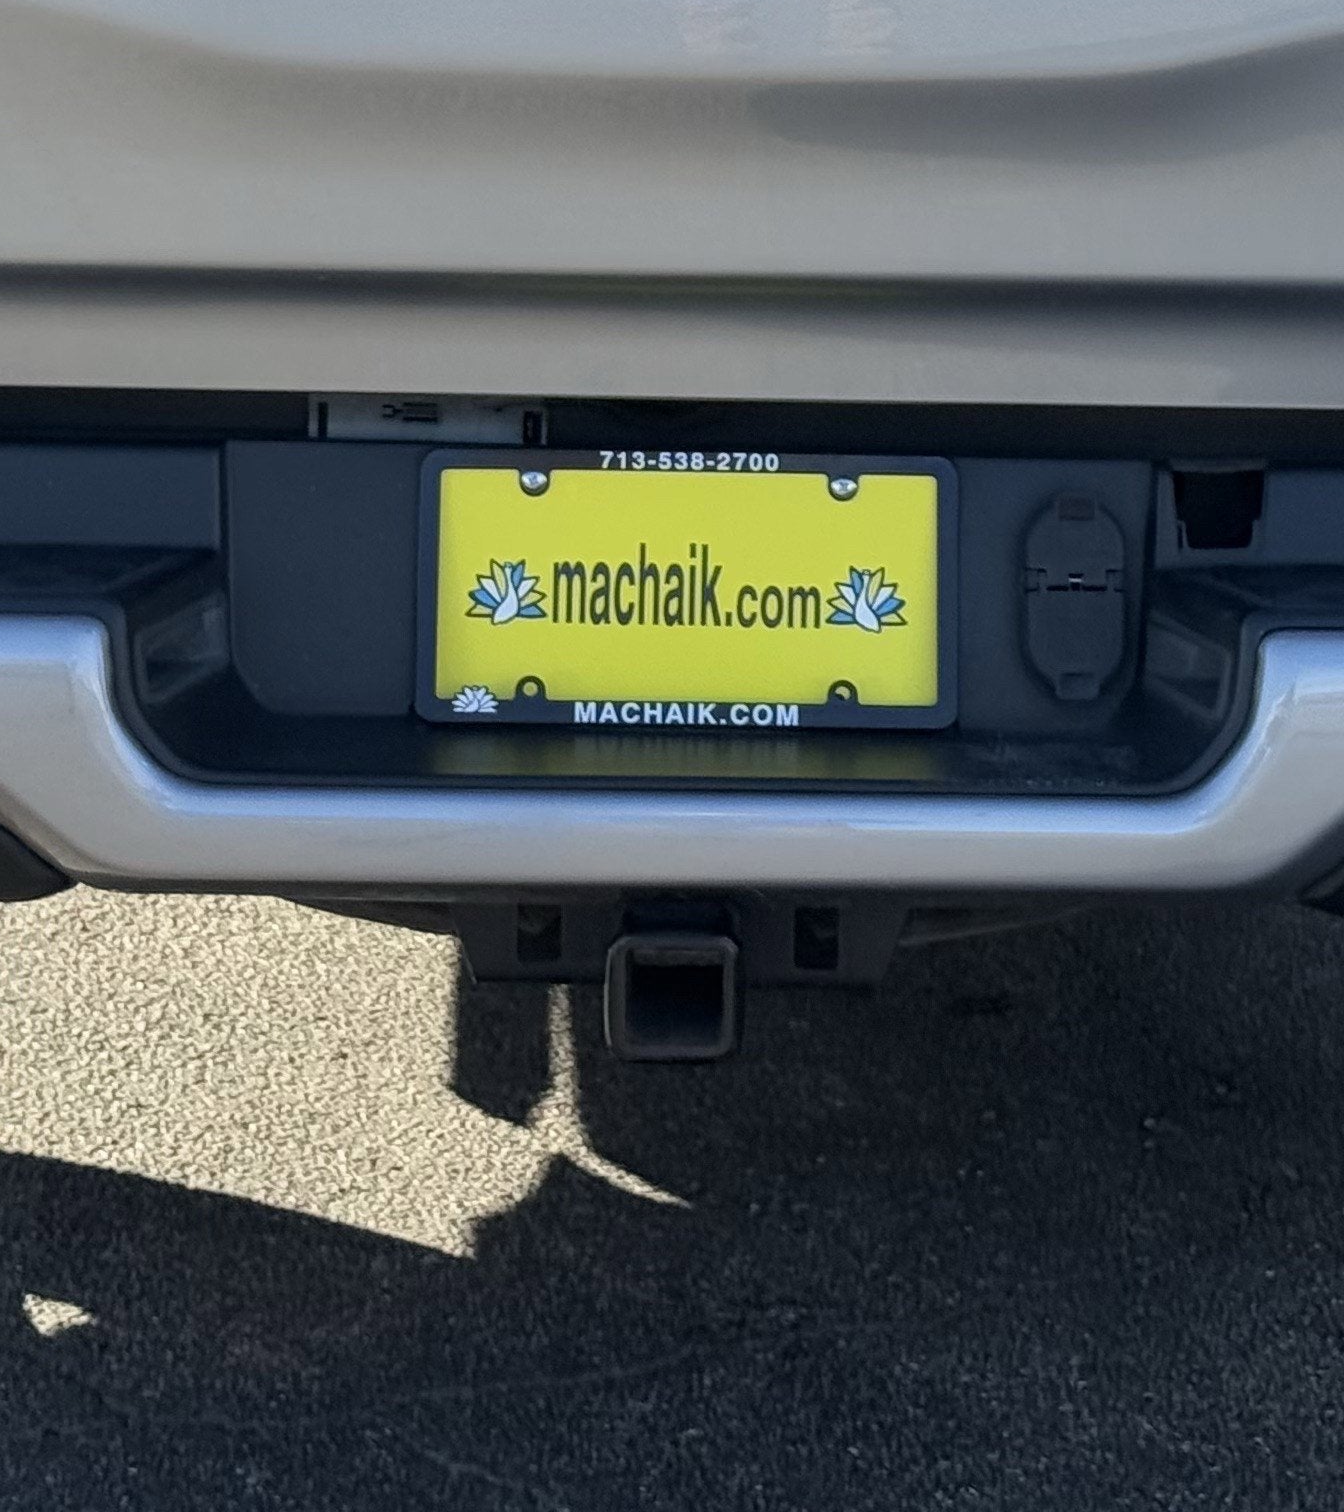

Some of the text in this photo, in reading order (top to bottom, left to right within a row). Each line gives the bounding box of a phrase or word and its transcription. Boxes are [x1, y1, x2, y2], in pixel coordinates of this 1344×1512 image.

[599, 450, 779, 472] 713-538-2700
[552, 543, 822, 629] machaik.com
[573, 700, 801, 727] MACHAIK.COM
